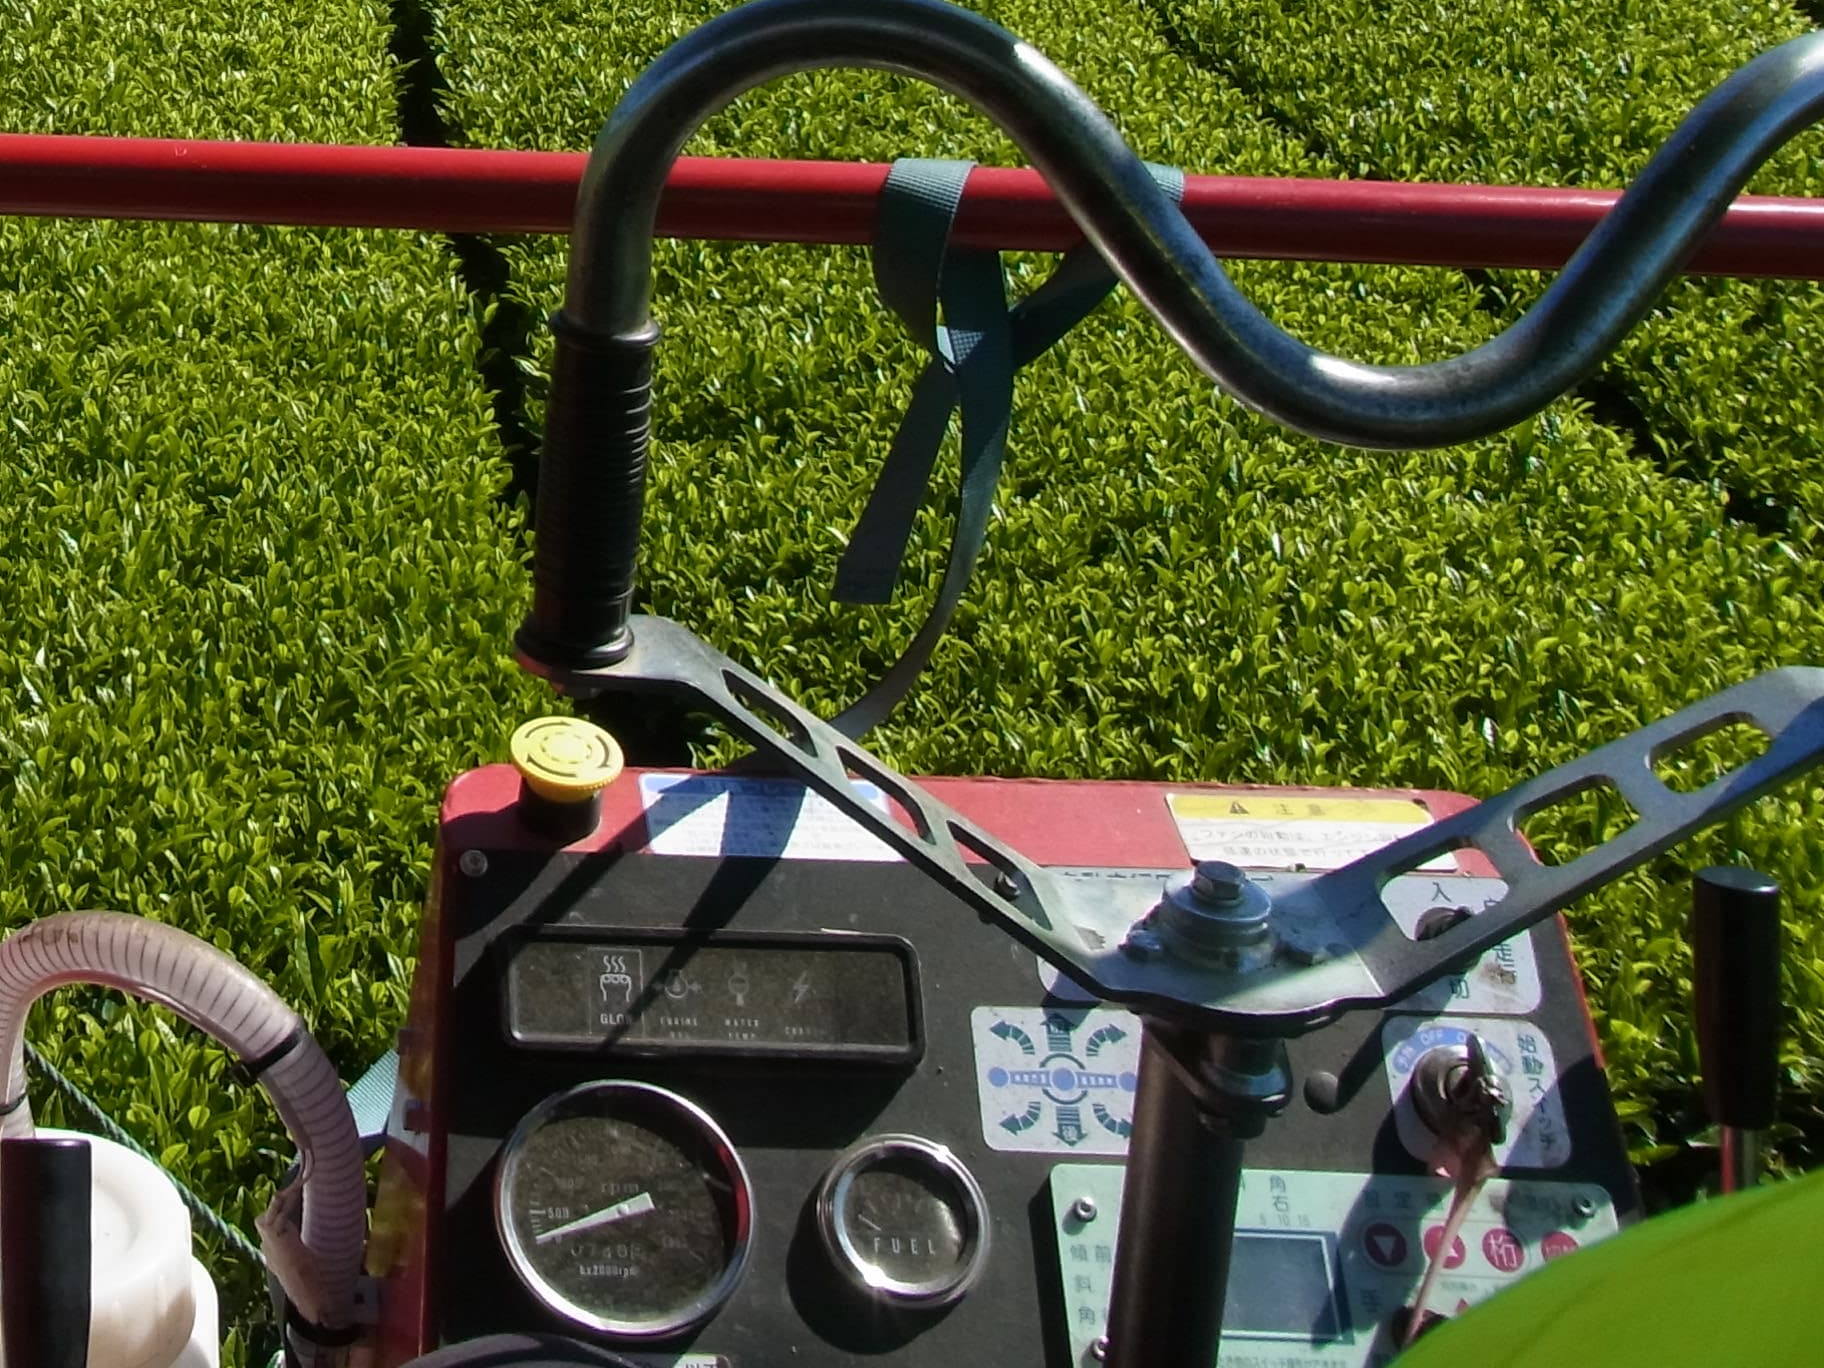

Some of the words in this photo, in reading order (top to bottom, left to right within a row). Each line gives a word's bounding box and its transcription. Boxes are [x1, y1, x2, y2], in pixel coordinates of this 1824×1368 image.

[1431, 882, 1453, 903] 入
[1517, 1033, 1556, 1151] 始動スイッチ
[601, 1183, 639, 1196] rpm
[547, 1207, 570, 1219] 500
[873, 1237, 936, 1254] FUEL
